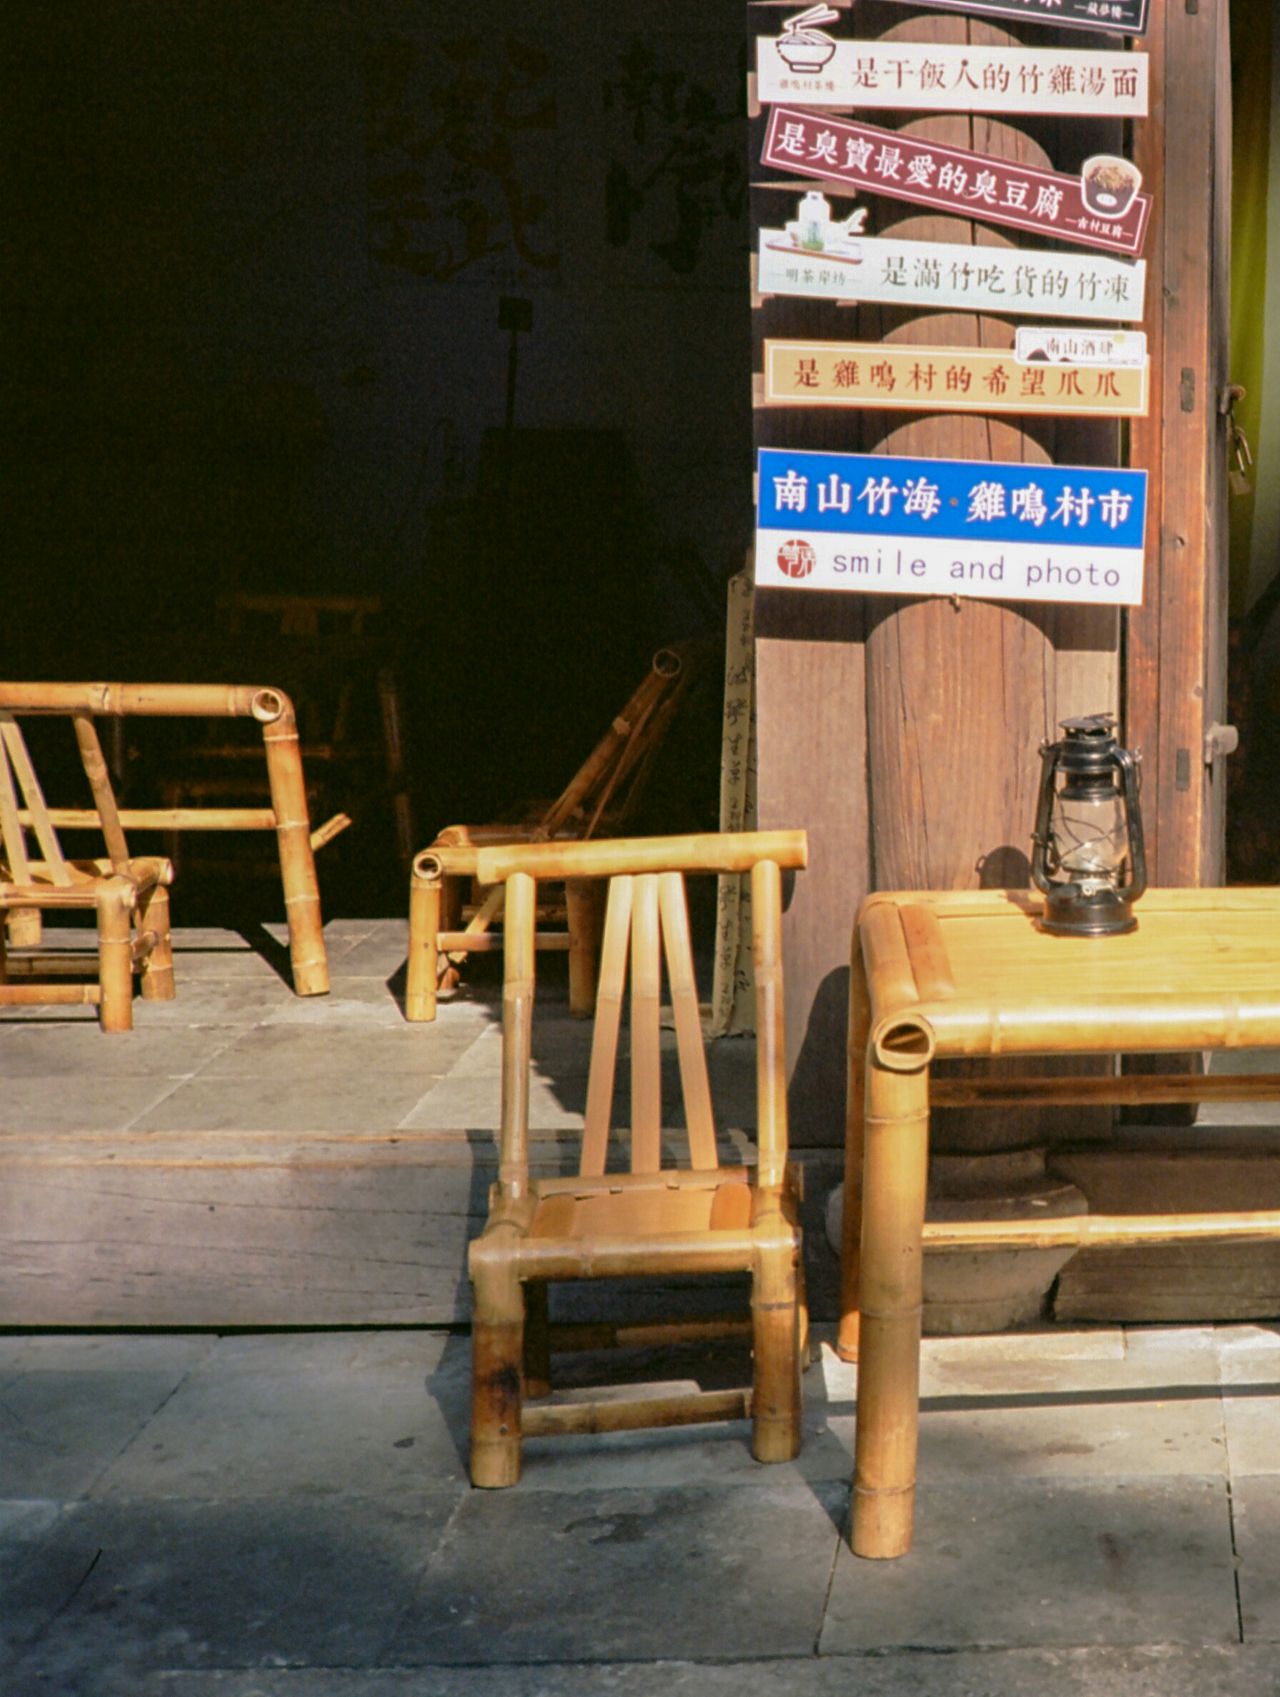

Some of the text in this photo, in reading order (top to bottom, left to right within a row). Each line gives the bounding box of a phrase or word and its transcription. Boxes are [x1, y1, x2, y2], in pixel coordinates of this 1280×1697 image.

[775, 122, 1064, 221] 是臭寶最愛的臭豆腐
[794, 359, 1122, 397] 是雞鳴村的希望爪爪
[833, 548, 927, 577] smile
[950, 556, 1005, 581] and
[1026, 558, 1121, 587] photo
